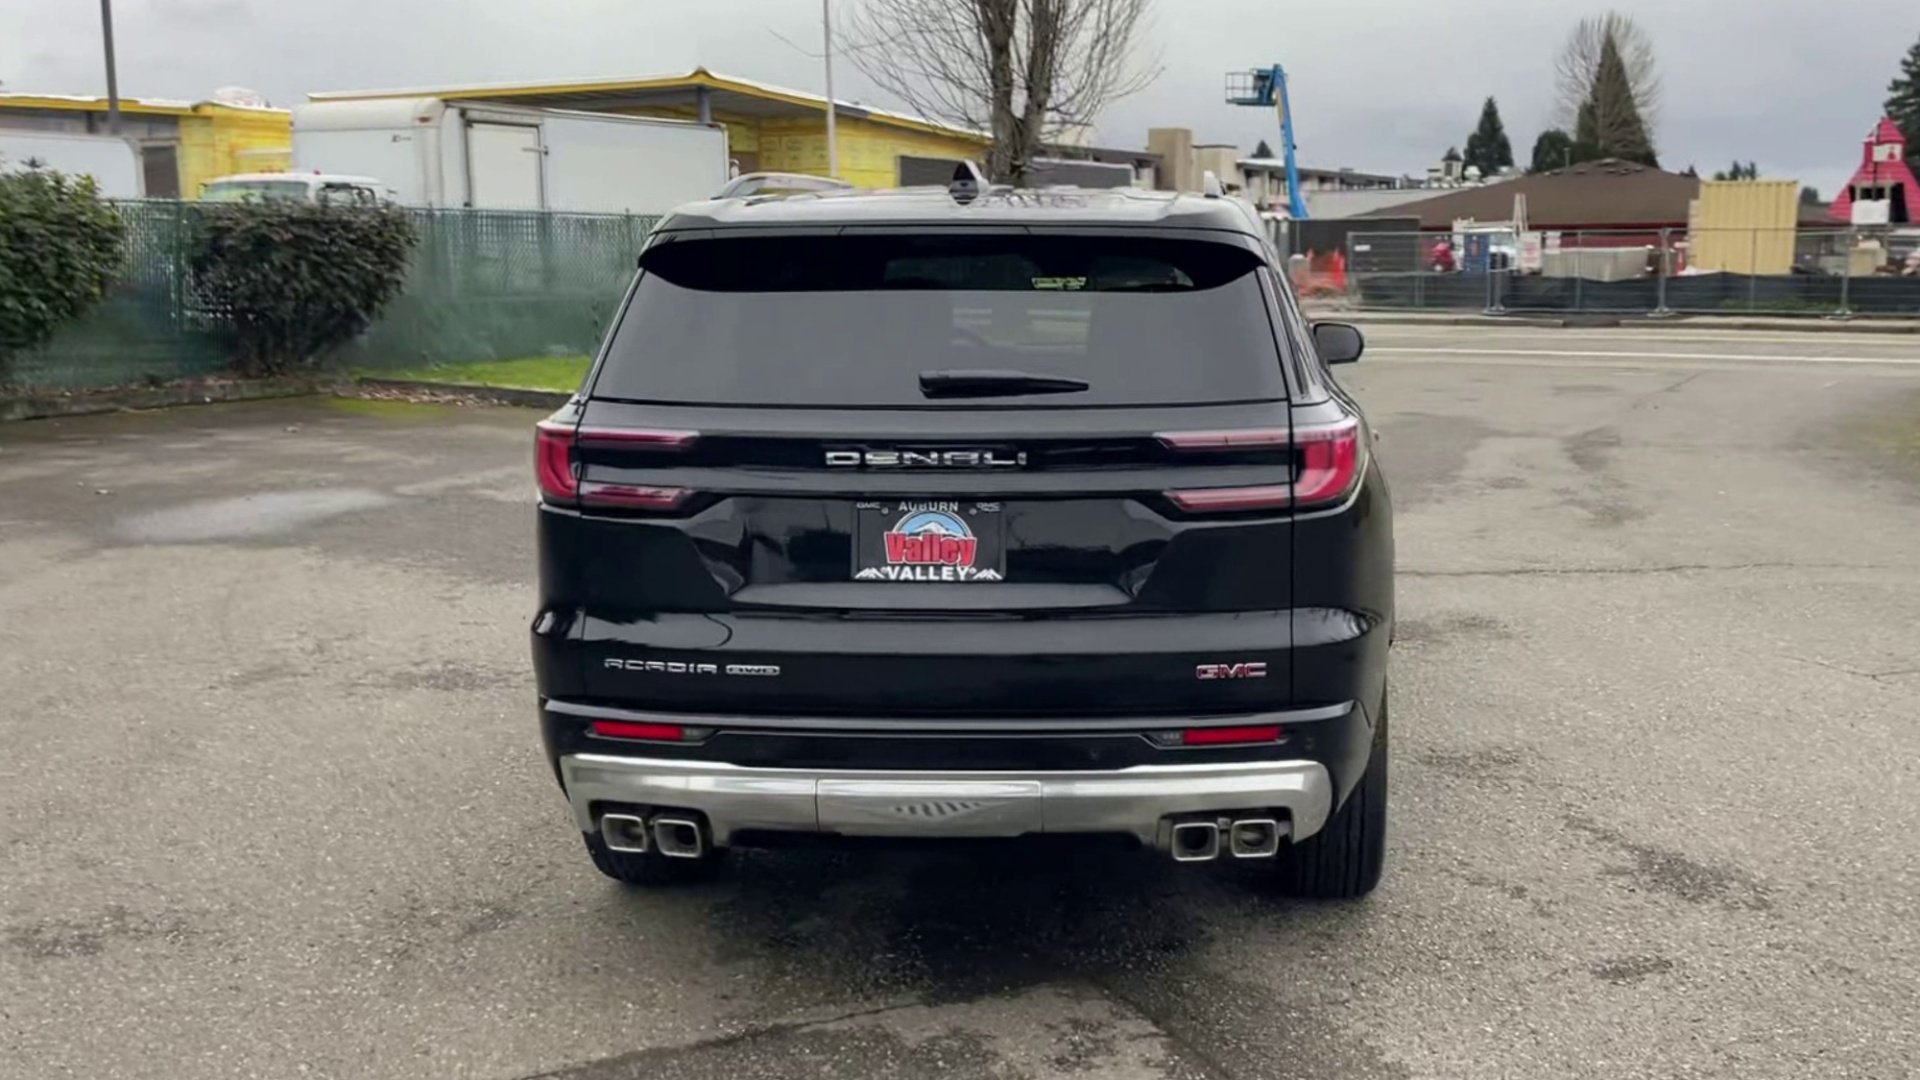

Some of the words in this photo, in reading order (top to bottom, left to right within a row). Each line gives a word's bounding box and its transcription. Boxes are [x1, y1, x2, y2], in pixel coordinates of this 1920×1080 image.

[825, 452, 1027, 465] DENALI
[898, 501, 959, 512] AUBURN
[884, 531, 978, 568] Valley
[885, 566, 971, 581] VALLEY
[604, 658, 717, 674] ACADIA
[1196, 662, 1267, 679] GMC
